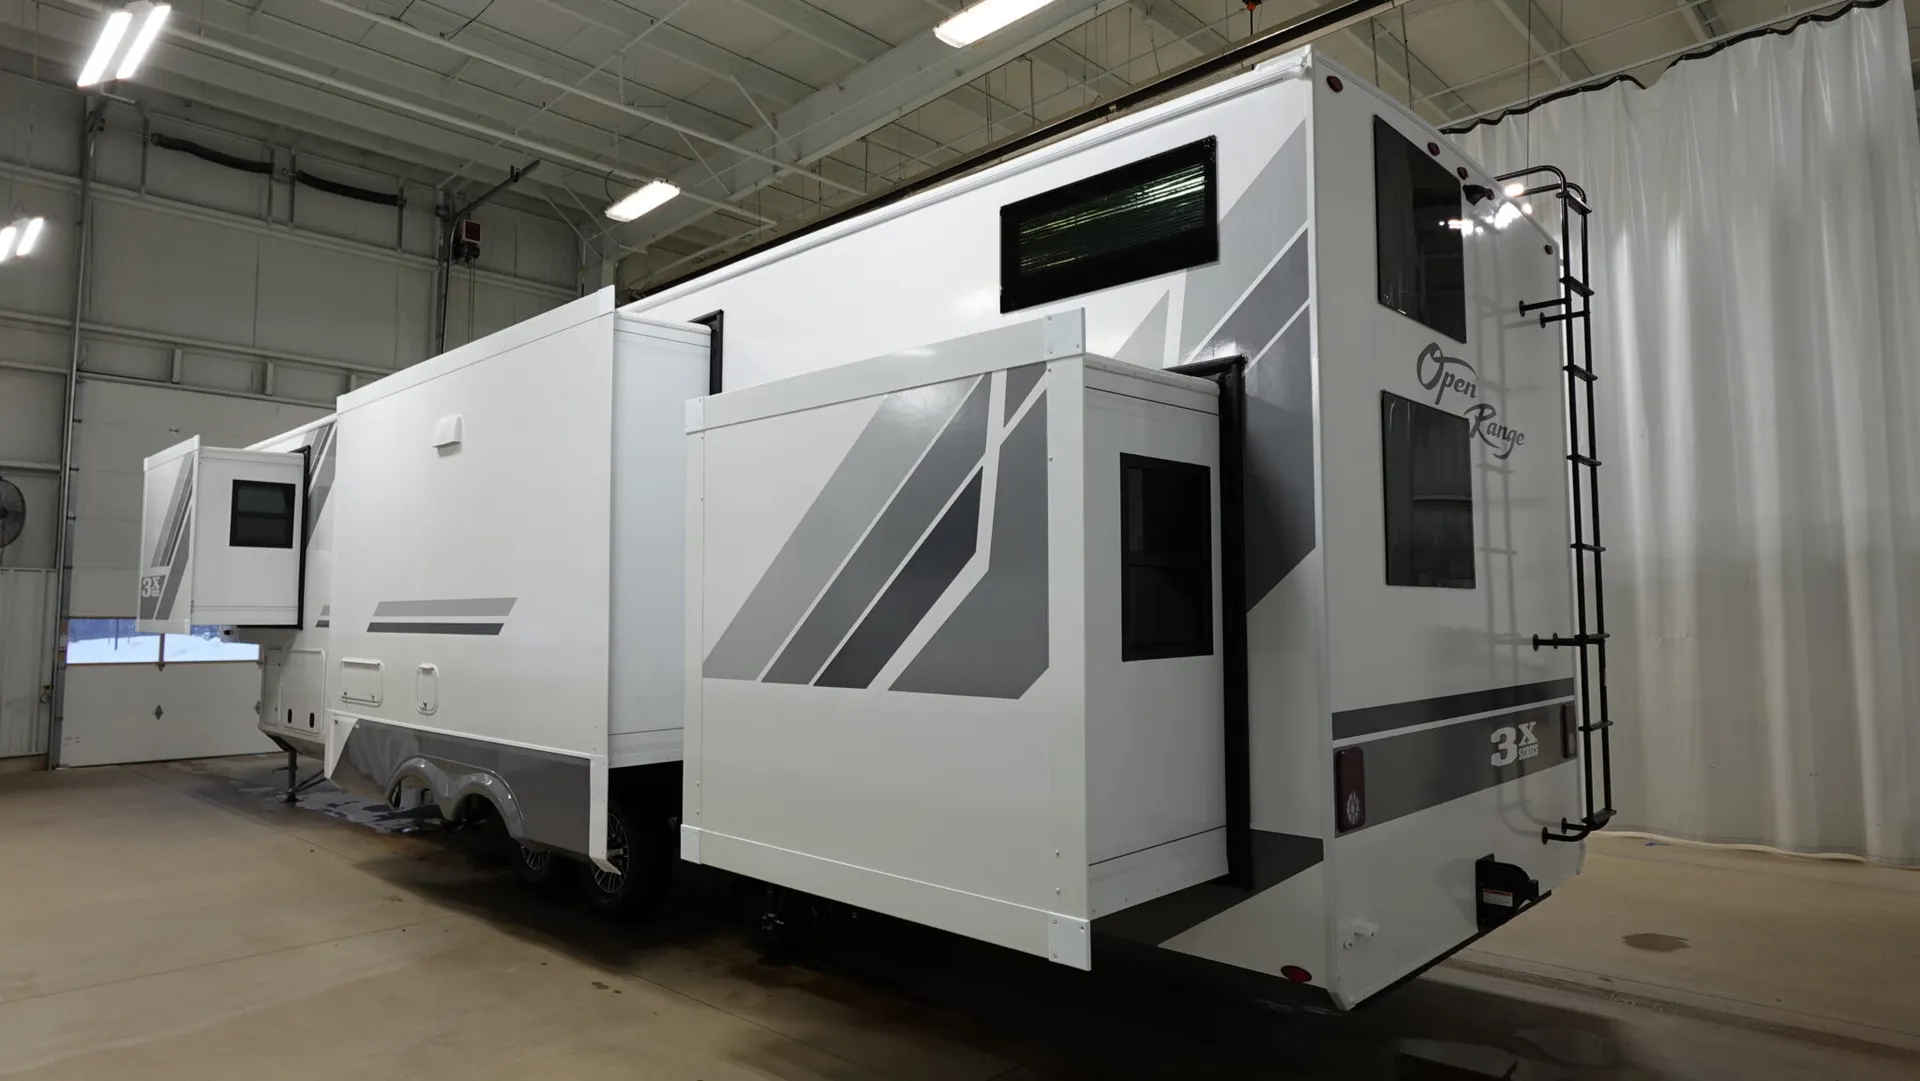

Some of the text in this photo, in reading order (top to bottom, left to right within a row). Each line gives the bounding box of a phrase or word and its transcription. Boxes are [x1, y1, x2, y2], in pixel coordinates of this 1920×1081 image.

[1416, 342, 1525, 459] Open Range
[142, 576, 160, 598] 3X
[1491, 721, 1538, 767] 3X
